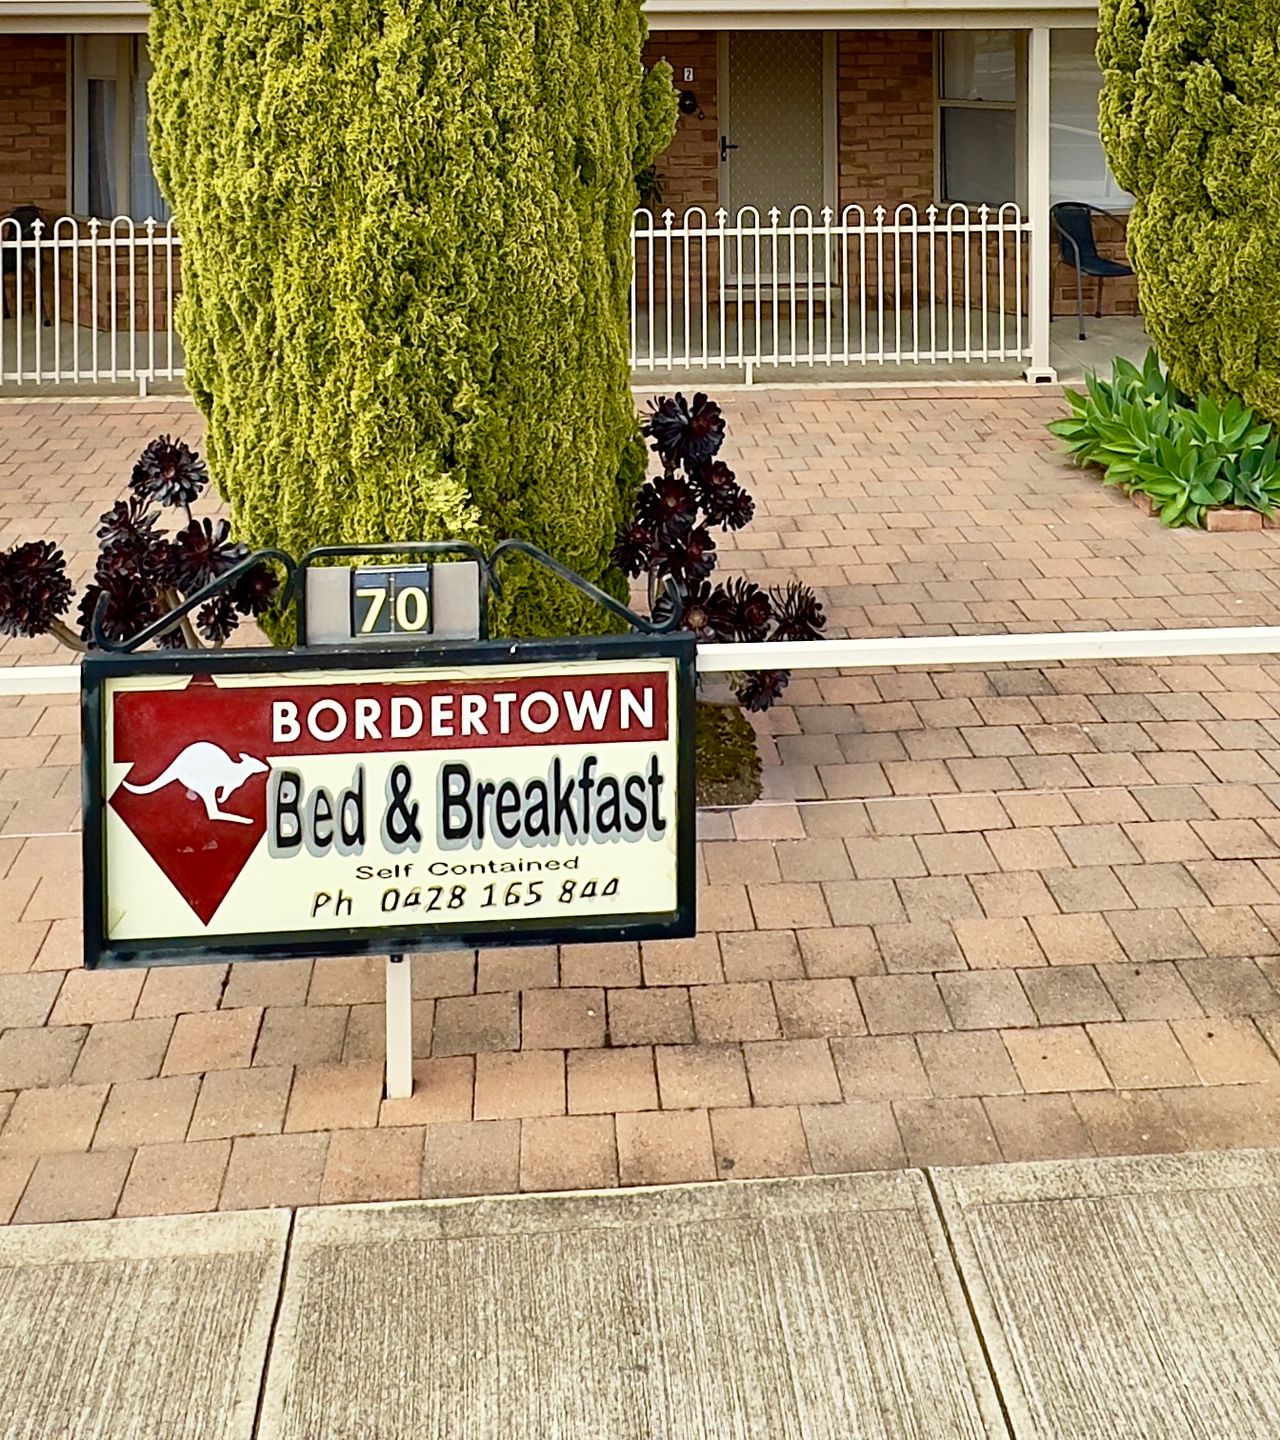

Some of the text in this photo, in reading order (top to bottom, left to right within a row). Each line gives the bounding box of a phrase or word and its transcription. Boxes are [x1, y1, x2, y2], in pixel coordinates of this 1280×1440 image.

[355, 586, 428, 633] 70
[272, 687, 654, 743] BORDERTOWN
[275, 753, 666, 849] Bed & Breakfast
[355, 855, 579, 880] Self Contained
[312, 877, 620, 918] Ph 0428 165 844
